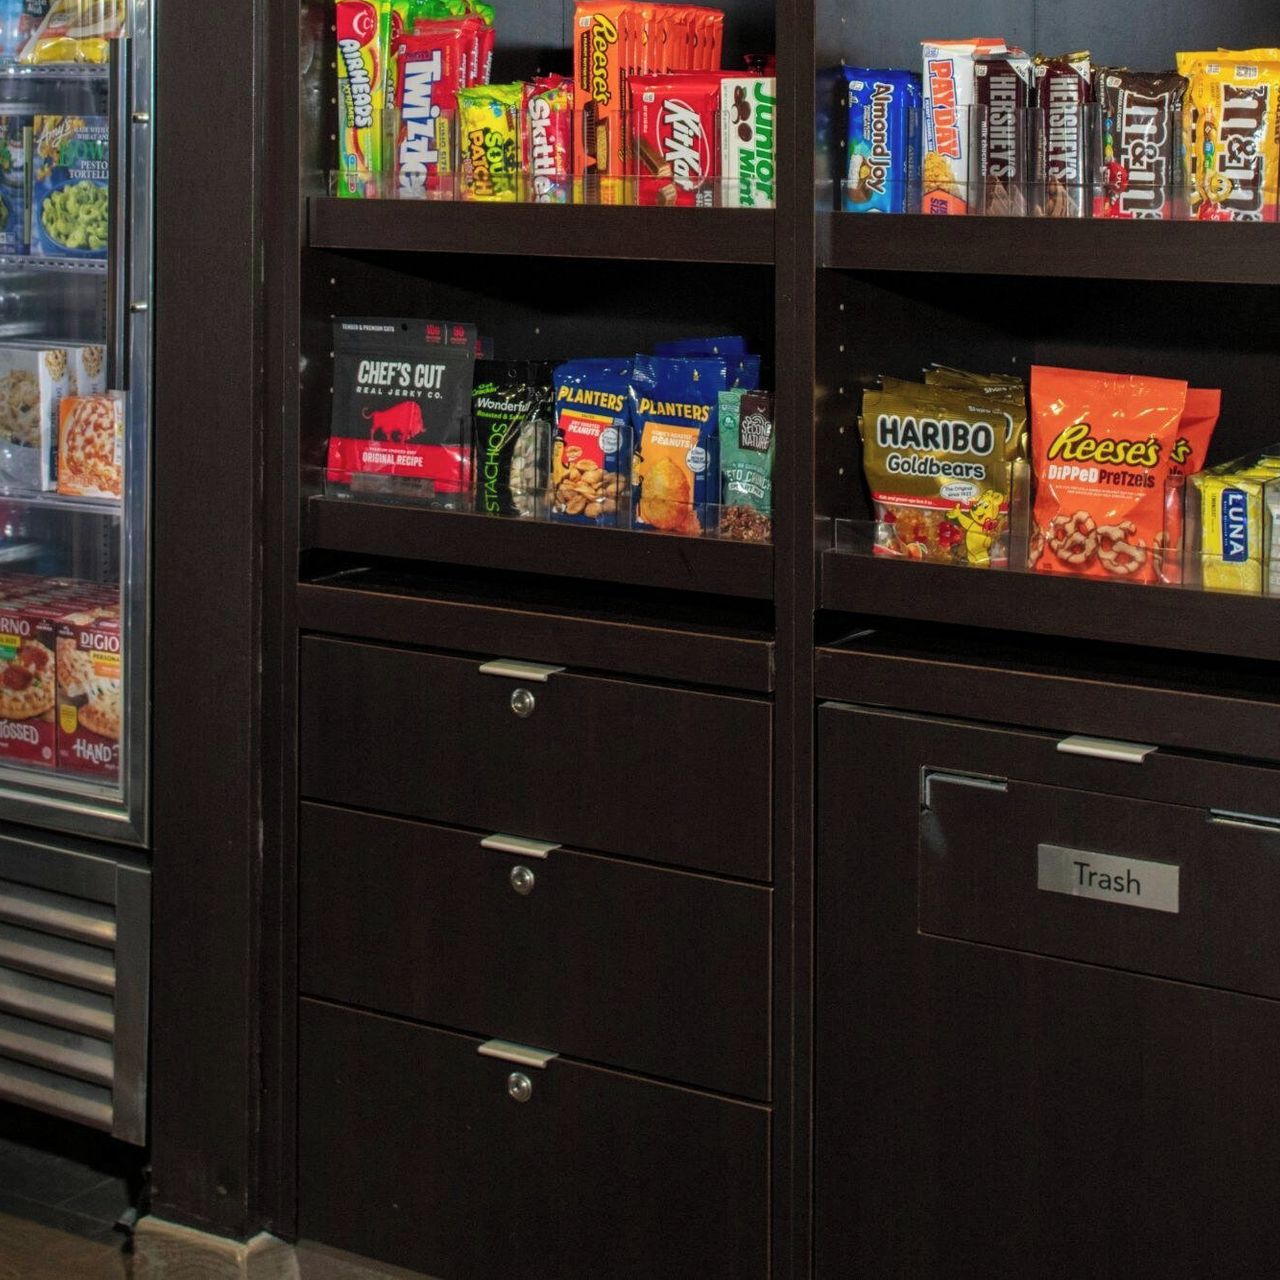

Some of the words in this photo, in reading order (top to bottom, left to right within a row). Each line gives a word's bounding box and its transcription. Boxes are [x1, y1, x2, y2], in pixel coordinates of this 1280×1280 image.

[592, 14, 619, 106] Reese's
[338, 39, 373, 128] AIRHEADS
[929, 60, 960, 159] PAYDAY
[754, 82, 778, 200] Junior
[989, 76, 1017, 177] HERSHEY'S
[1048, 77, 1078, 180] HERSHEY'S
[80, 160, 108, 170] PESTO
[469, 129, 496, 196] PATCH
[485, 132, 510, 193] SOUR
[358, 360, 411, 387] CHEF'S
[414, 363, 445, 389] CUT
[356, 385, 382, 395] REAL
[388, 388, 422, 397] JERKY
[427, 391, 443, 400] CO.
[477, 397, 531, 413] Wonderful
[558, 385, 624, 412] PLANTERS
[477, 410, 502, 419] Roasted
[639, 398, 709, 422] PLANTERS
[568, 424, 600, 437] PEANUTS
[651, 435, 690, 449] PEANUTS
[741, 434, 770, 450] NATURE
[877, 415, 993, 455] HARIBO
[1048, 423, 1161, 467] Reese's
[362, 451, 395, 465] ORIGINAL
[396, 454, 424, 467] RECIPE
[887, 454, 985, 479] Goldbears
[1228, 494, 1244, 555] LUNA
[4, 636, 18, 645] SIZE
[1073, 861, 1141, 895] Trash
